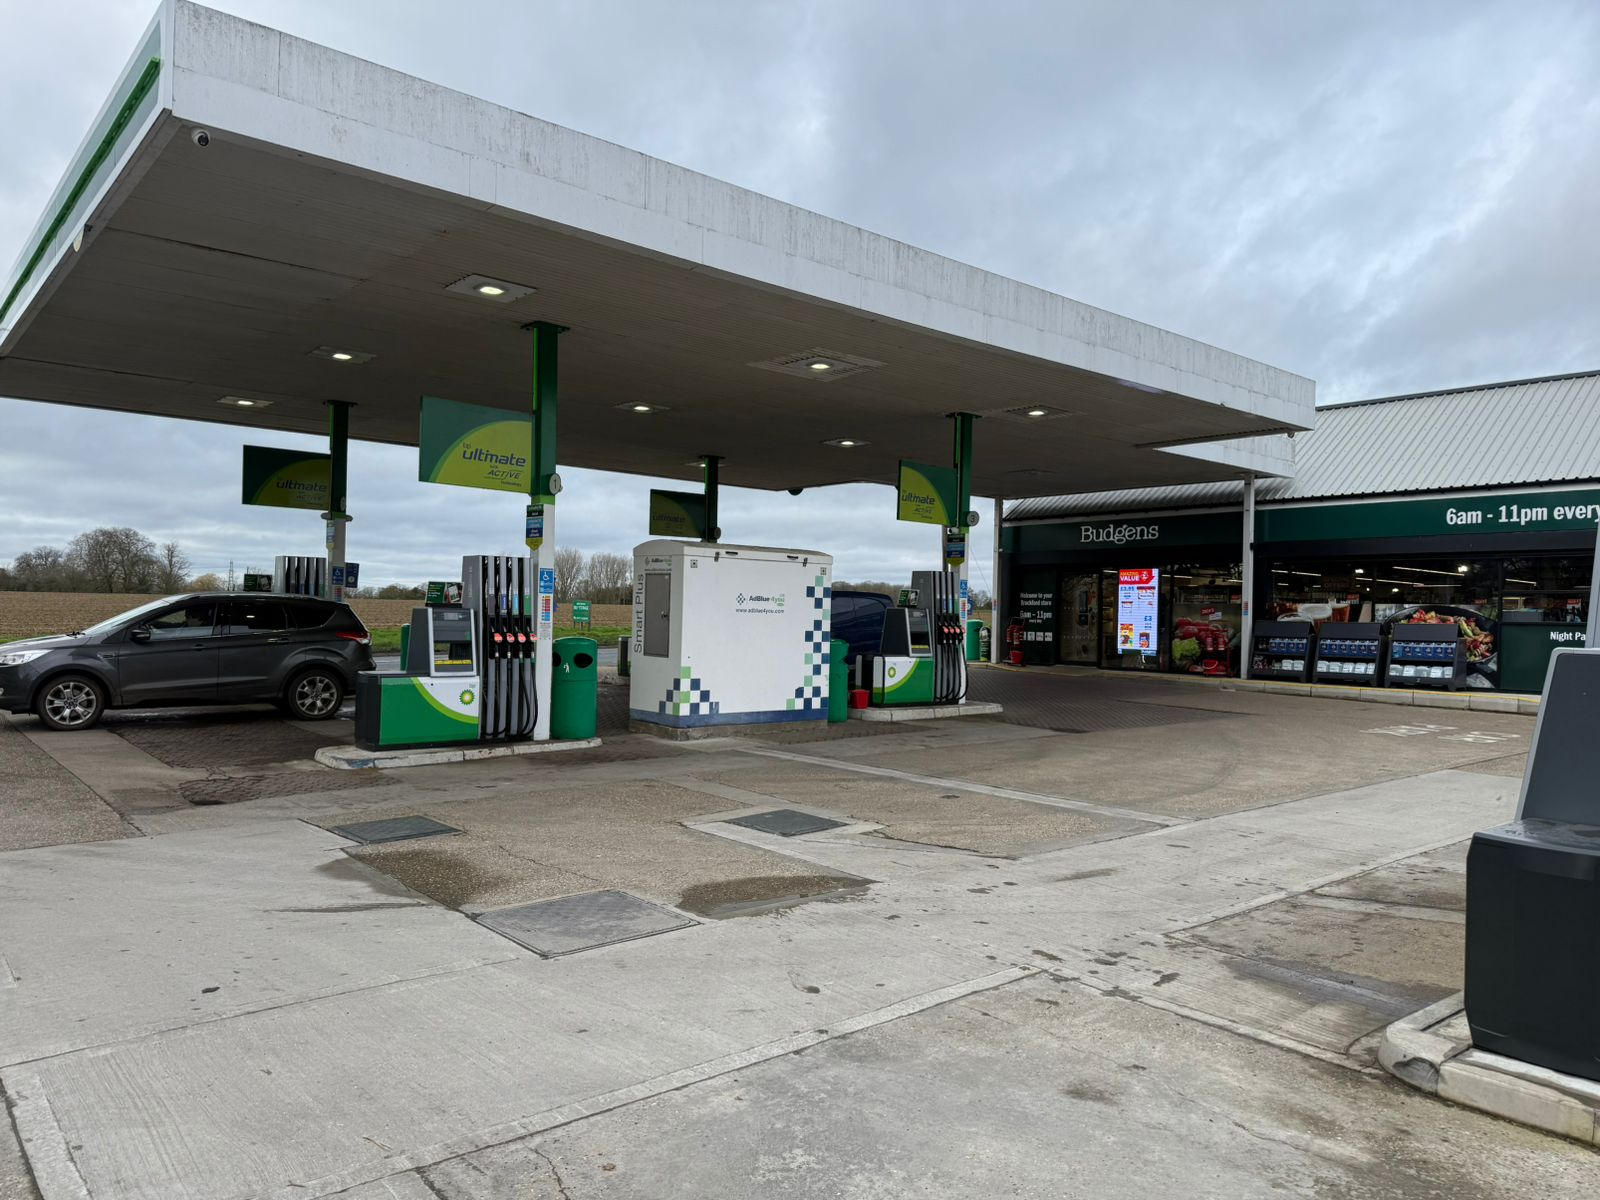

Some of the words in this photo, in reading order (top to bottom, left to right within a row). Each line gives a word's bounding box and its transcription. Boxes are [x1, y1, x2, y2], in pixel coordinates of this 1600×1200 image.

[462, 448, 526, 467] ultimate
[487, 469, 522, 480] ACTIVE
[276, 479, 327, 492] ultimate
[552, 478, 557, 489] 1
[901, 491, 935, 505] ultimate
[1446, 508, 1482, 525] 6am
[1498, 504, 1548, 526] 11pm
[1553, 504, 1600, 523] every
[1080, 524, 1159, 544] Budgens
[635, 574, 644, 605] Plus
[1037, 610, 1052, 620] 11pm
[634, 610, 644, 654] Smart
[1550, 631, 1573, 642] Night
[1574, 632, 1586, 641] Pa
